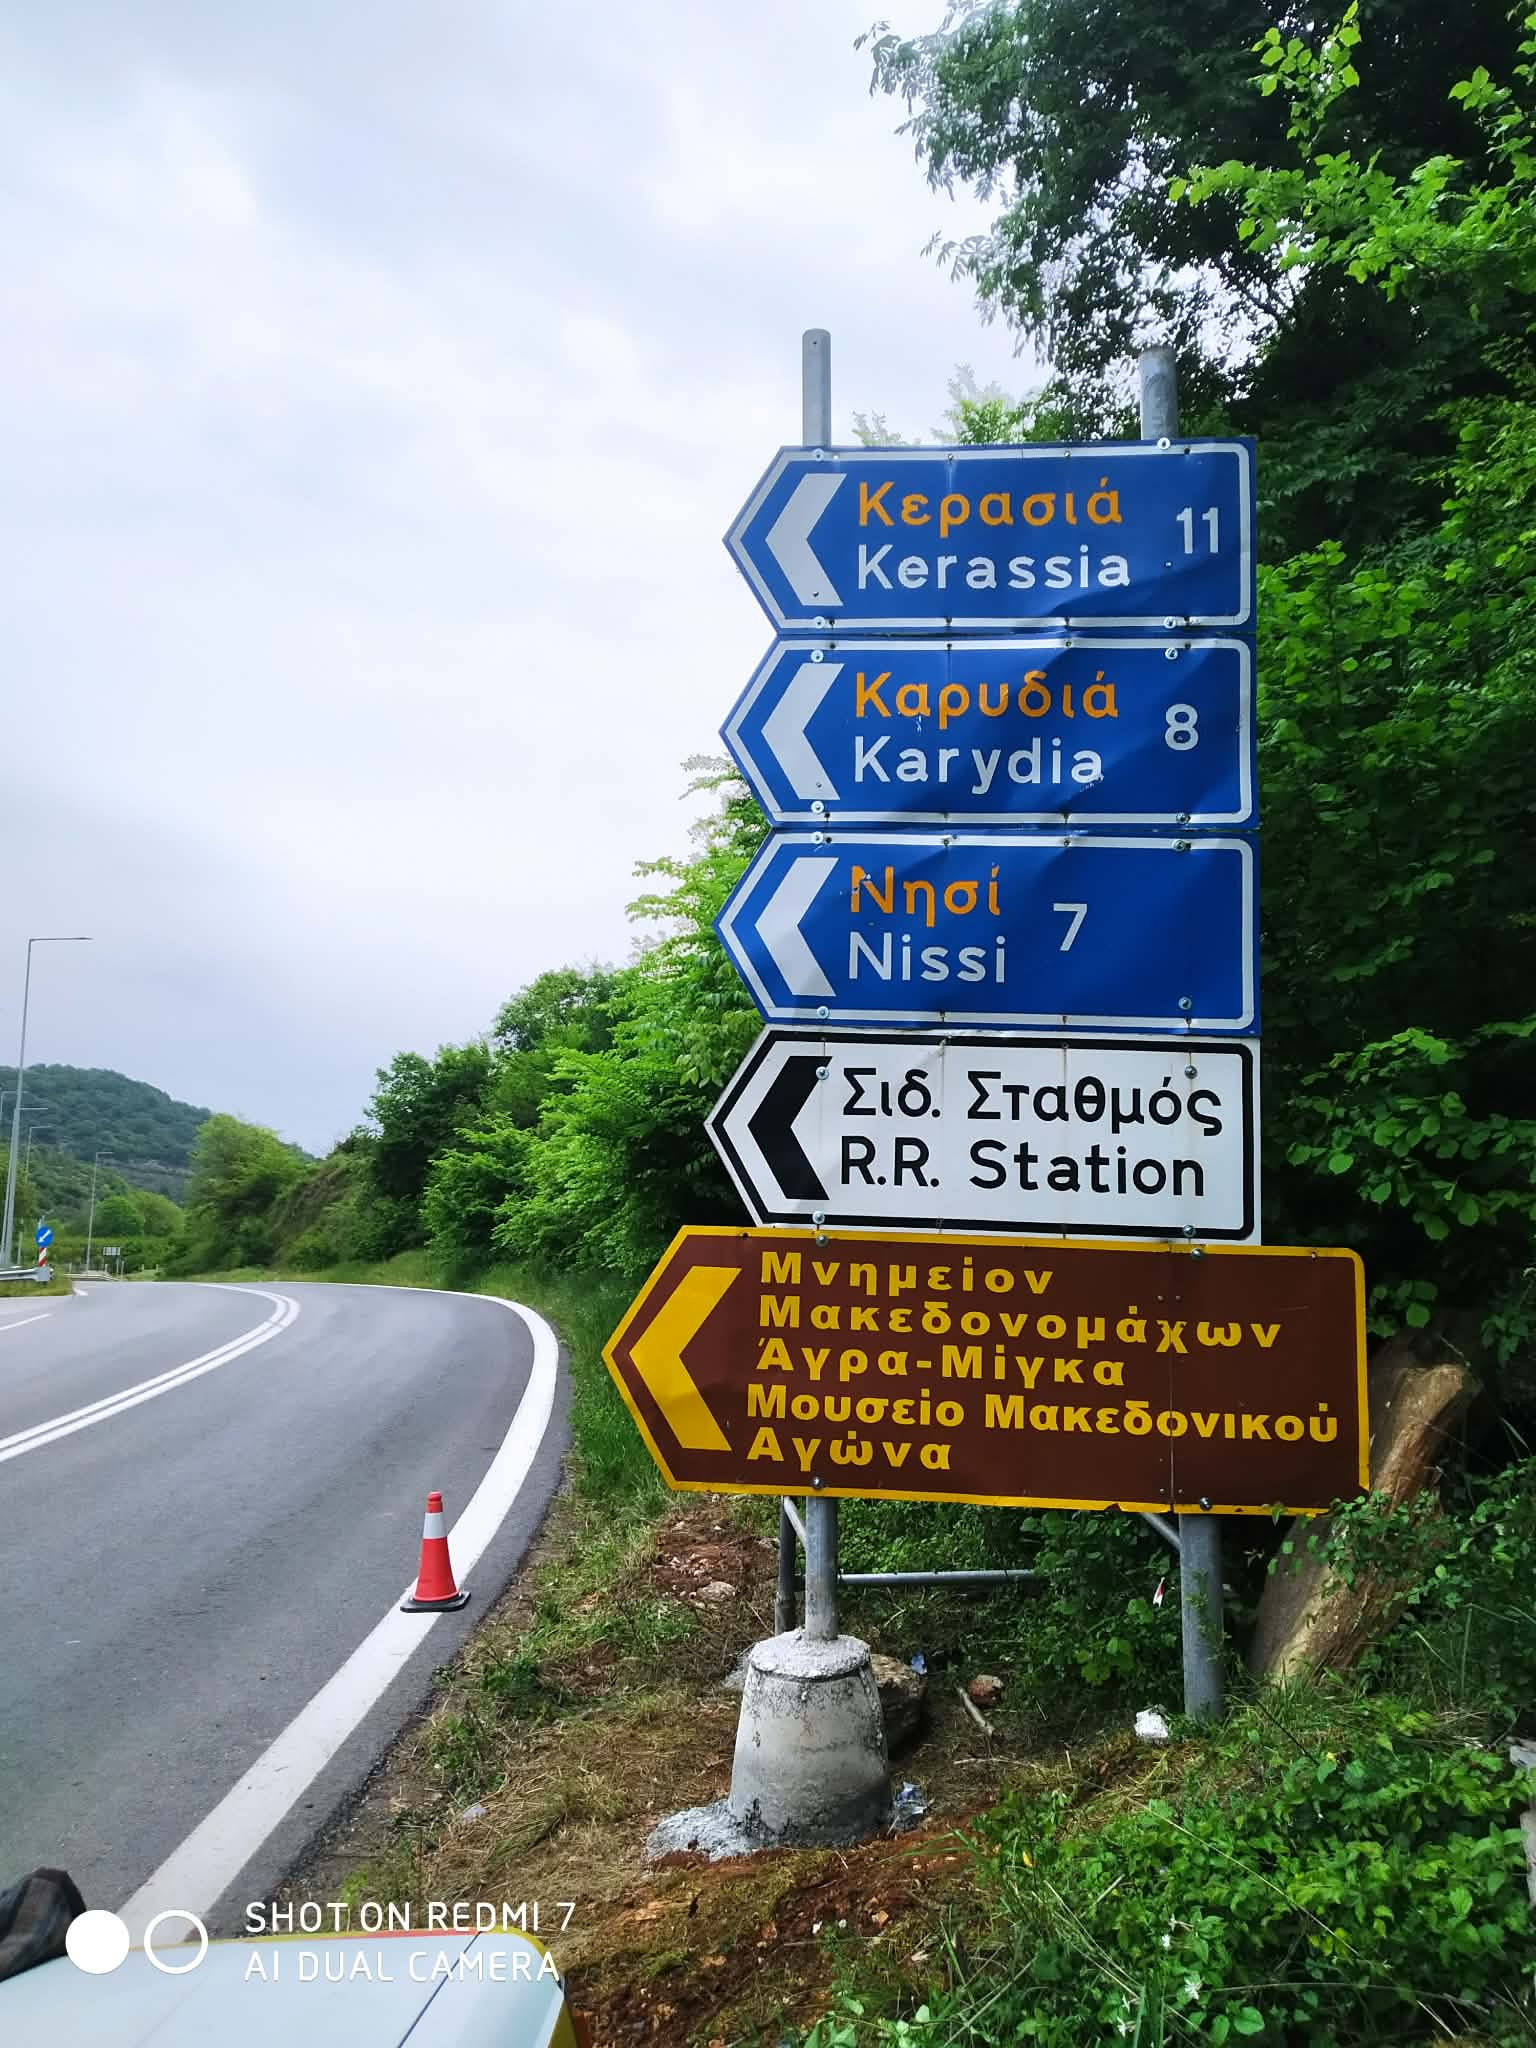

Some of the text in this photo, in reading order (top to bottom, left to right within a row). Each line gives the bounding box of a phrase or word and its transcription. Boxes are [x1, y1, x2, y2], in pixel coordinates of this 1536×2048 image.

[858, 477, 1122, 537] Κερασιά
[1176, 507, 1219, 554] 11
[858, 544, 1131, 589] Kerassia
[856, 670, 1118, 729] Καρυδιά
[1165, 703, 1198, 751] 8
[854, 735, 1103, 795] Karydia
[850, 863, 1000, 928] Νησί
[1052, 903, 1088, 951] 7
[848, 931, 1006, 983] Nissi
[842, 1067, 1222, 1136] Σιδ. Σταθμός
[841, 1135, 1204, 1197] R.R. Station
[760, 1251, 1054, 1296] Μνημείον
[759, 1294, 1281, 1354] Μακεδονομάχων
[757, 1336, 1125, 1387] Άγρα-Μίγκα
[746, 1384, 1338, 1443] Μουσείο Μακεδονικού
[747, 1427, 952, 1472] Αγώνα
